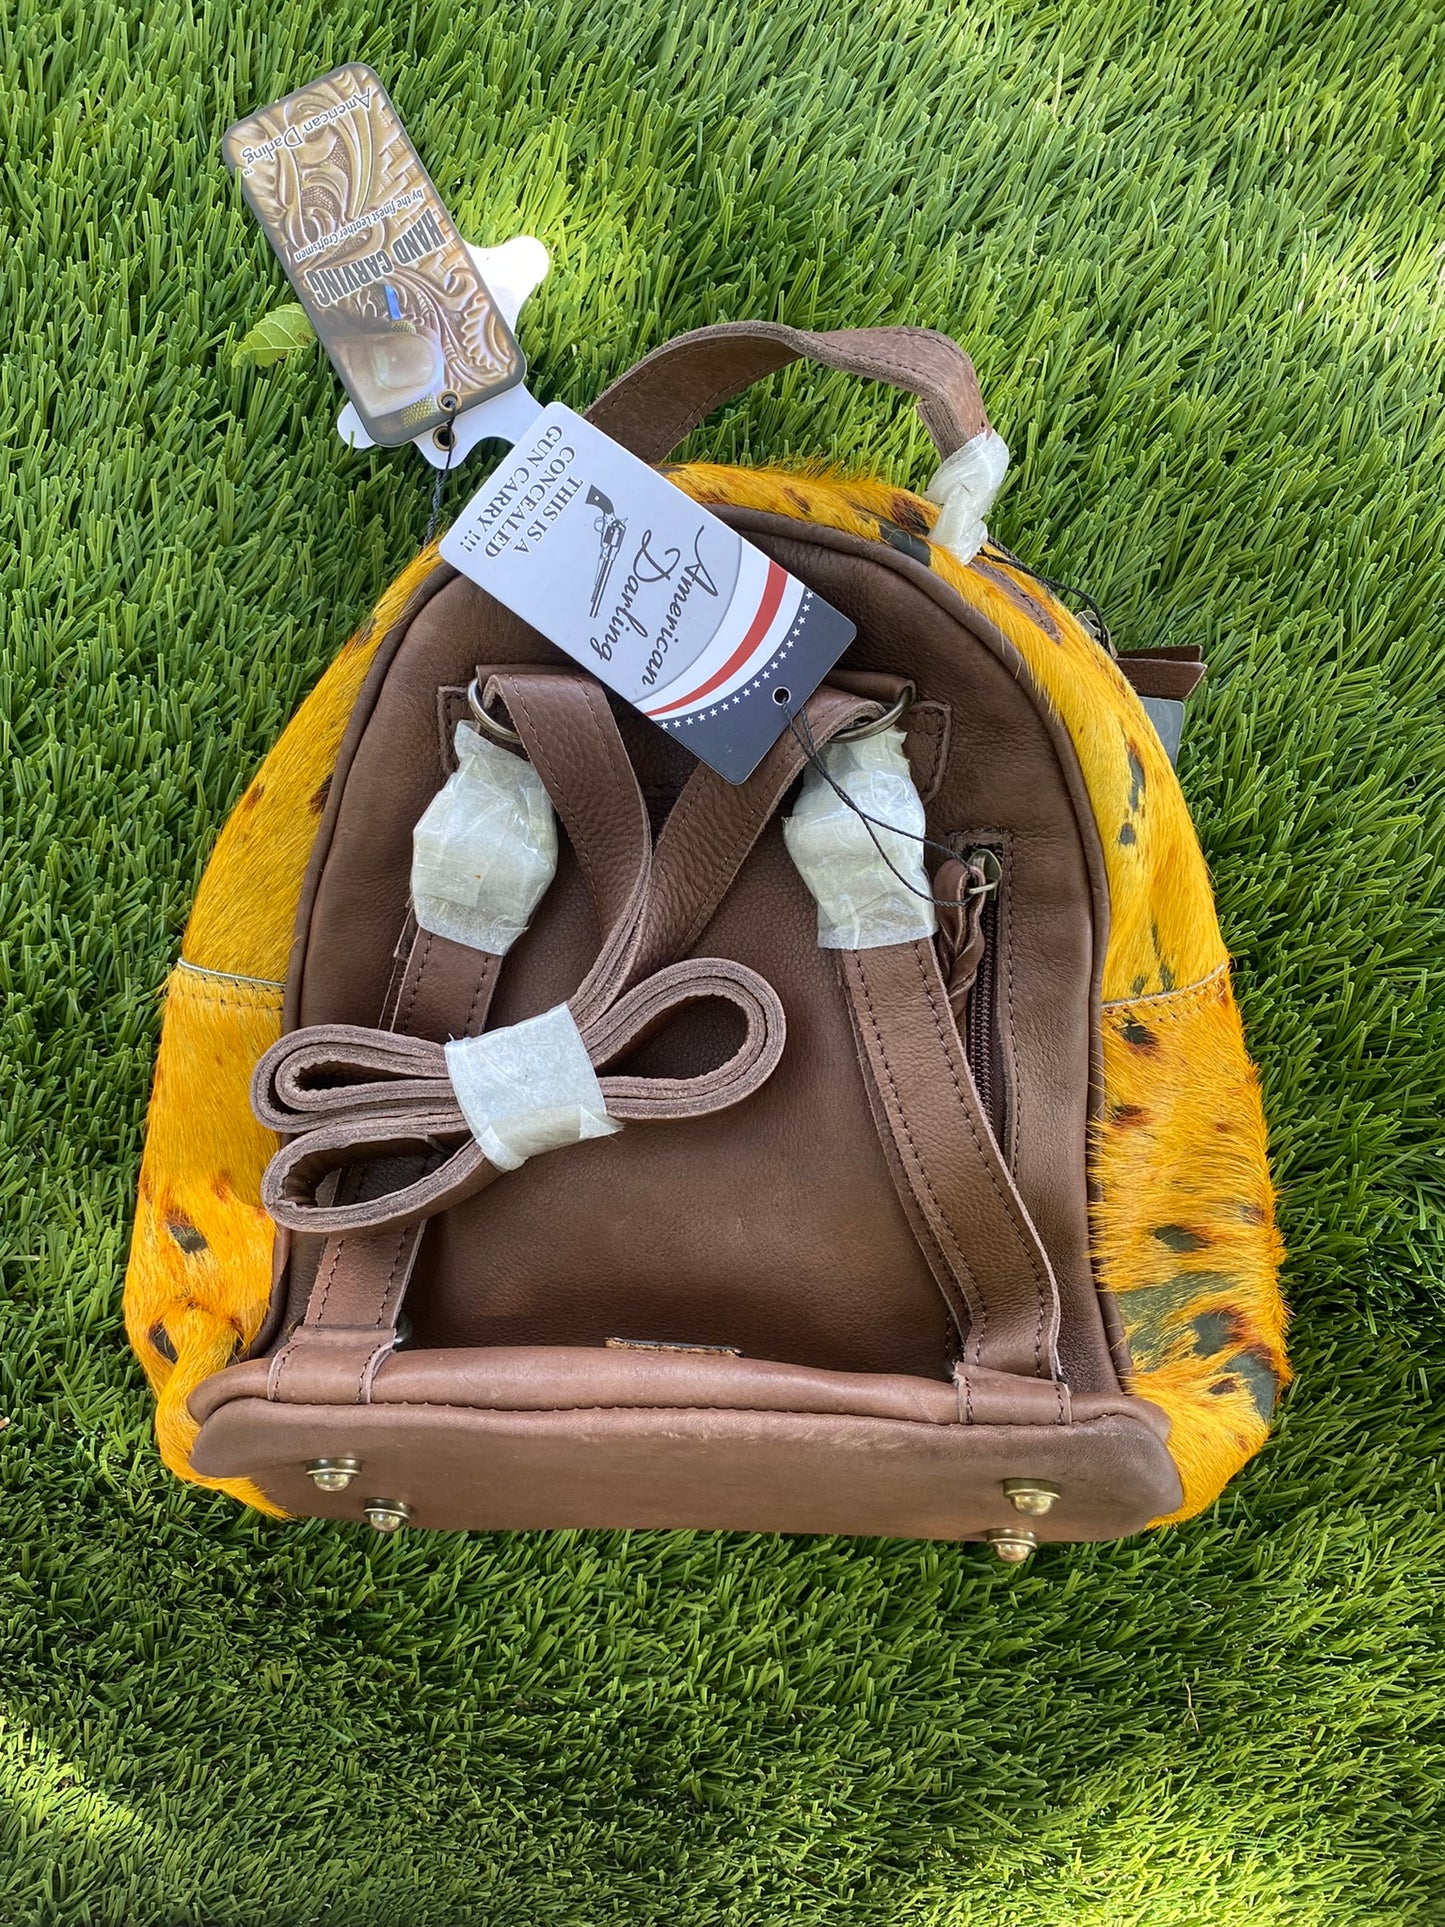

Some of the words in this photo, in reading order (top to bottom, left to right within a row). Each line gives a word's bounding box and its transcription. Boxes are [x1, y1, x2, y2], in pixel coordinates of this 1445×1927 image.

[302, 87, 371, 132] American
[370, 201, 398, 225] finest
[397, 194, 412, 209] the
[412, 188, 425, 201] by
[294, 232, 339, 263] Craftsmen
[339, 217, 372, 241] Leather
[391, 207, 447, 265] HAND
[305, 250, 395, 307] CARVING
[526, 425, 563, 468] GUN
[476, 466, 530, 533] CARRY
[484, 446, 576, 558] CONCEALED
[542, 476, 584, 521] THIS
[513, 538, 530, 554] A
[526, 519, 549, 542] IS
[589, 529, 681, 662] Darling
[641, 525, 719, 686] American
